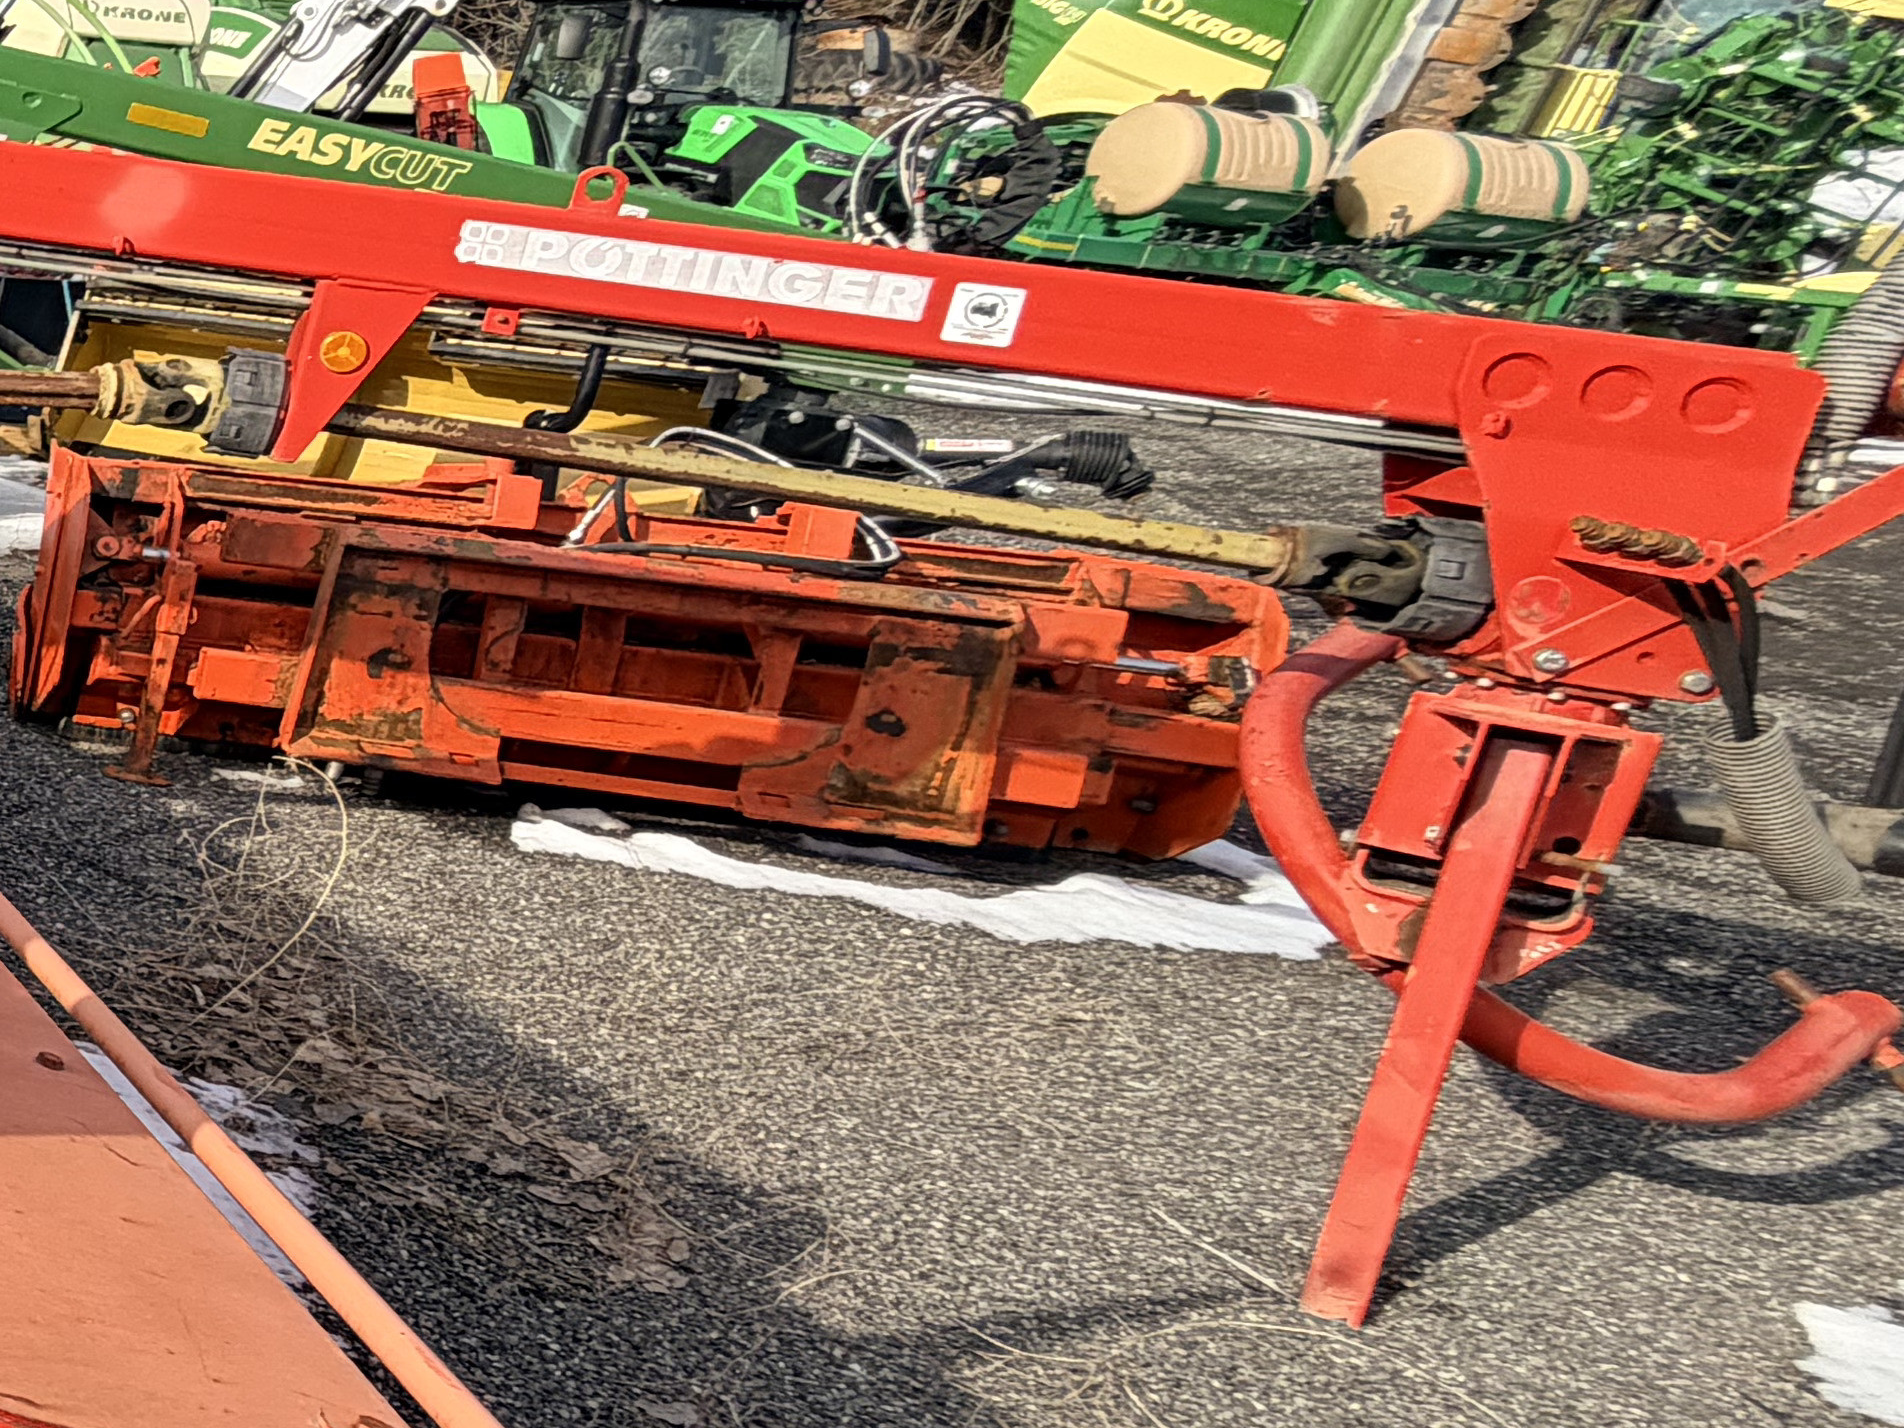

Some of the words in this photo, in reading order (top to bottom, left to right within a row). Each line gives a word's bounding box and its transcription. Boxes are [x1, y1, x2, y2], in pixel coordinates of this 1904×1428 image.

[103, 5, 186, 24] KRONE
[248, 117, 473, 191] EASYCUT
[523, 228, 931, 322] PÖTTINGER
